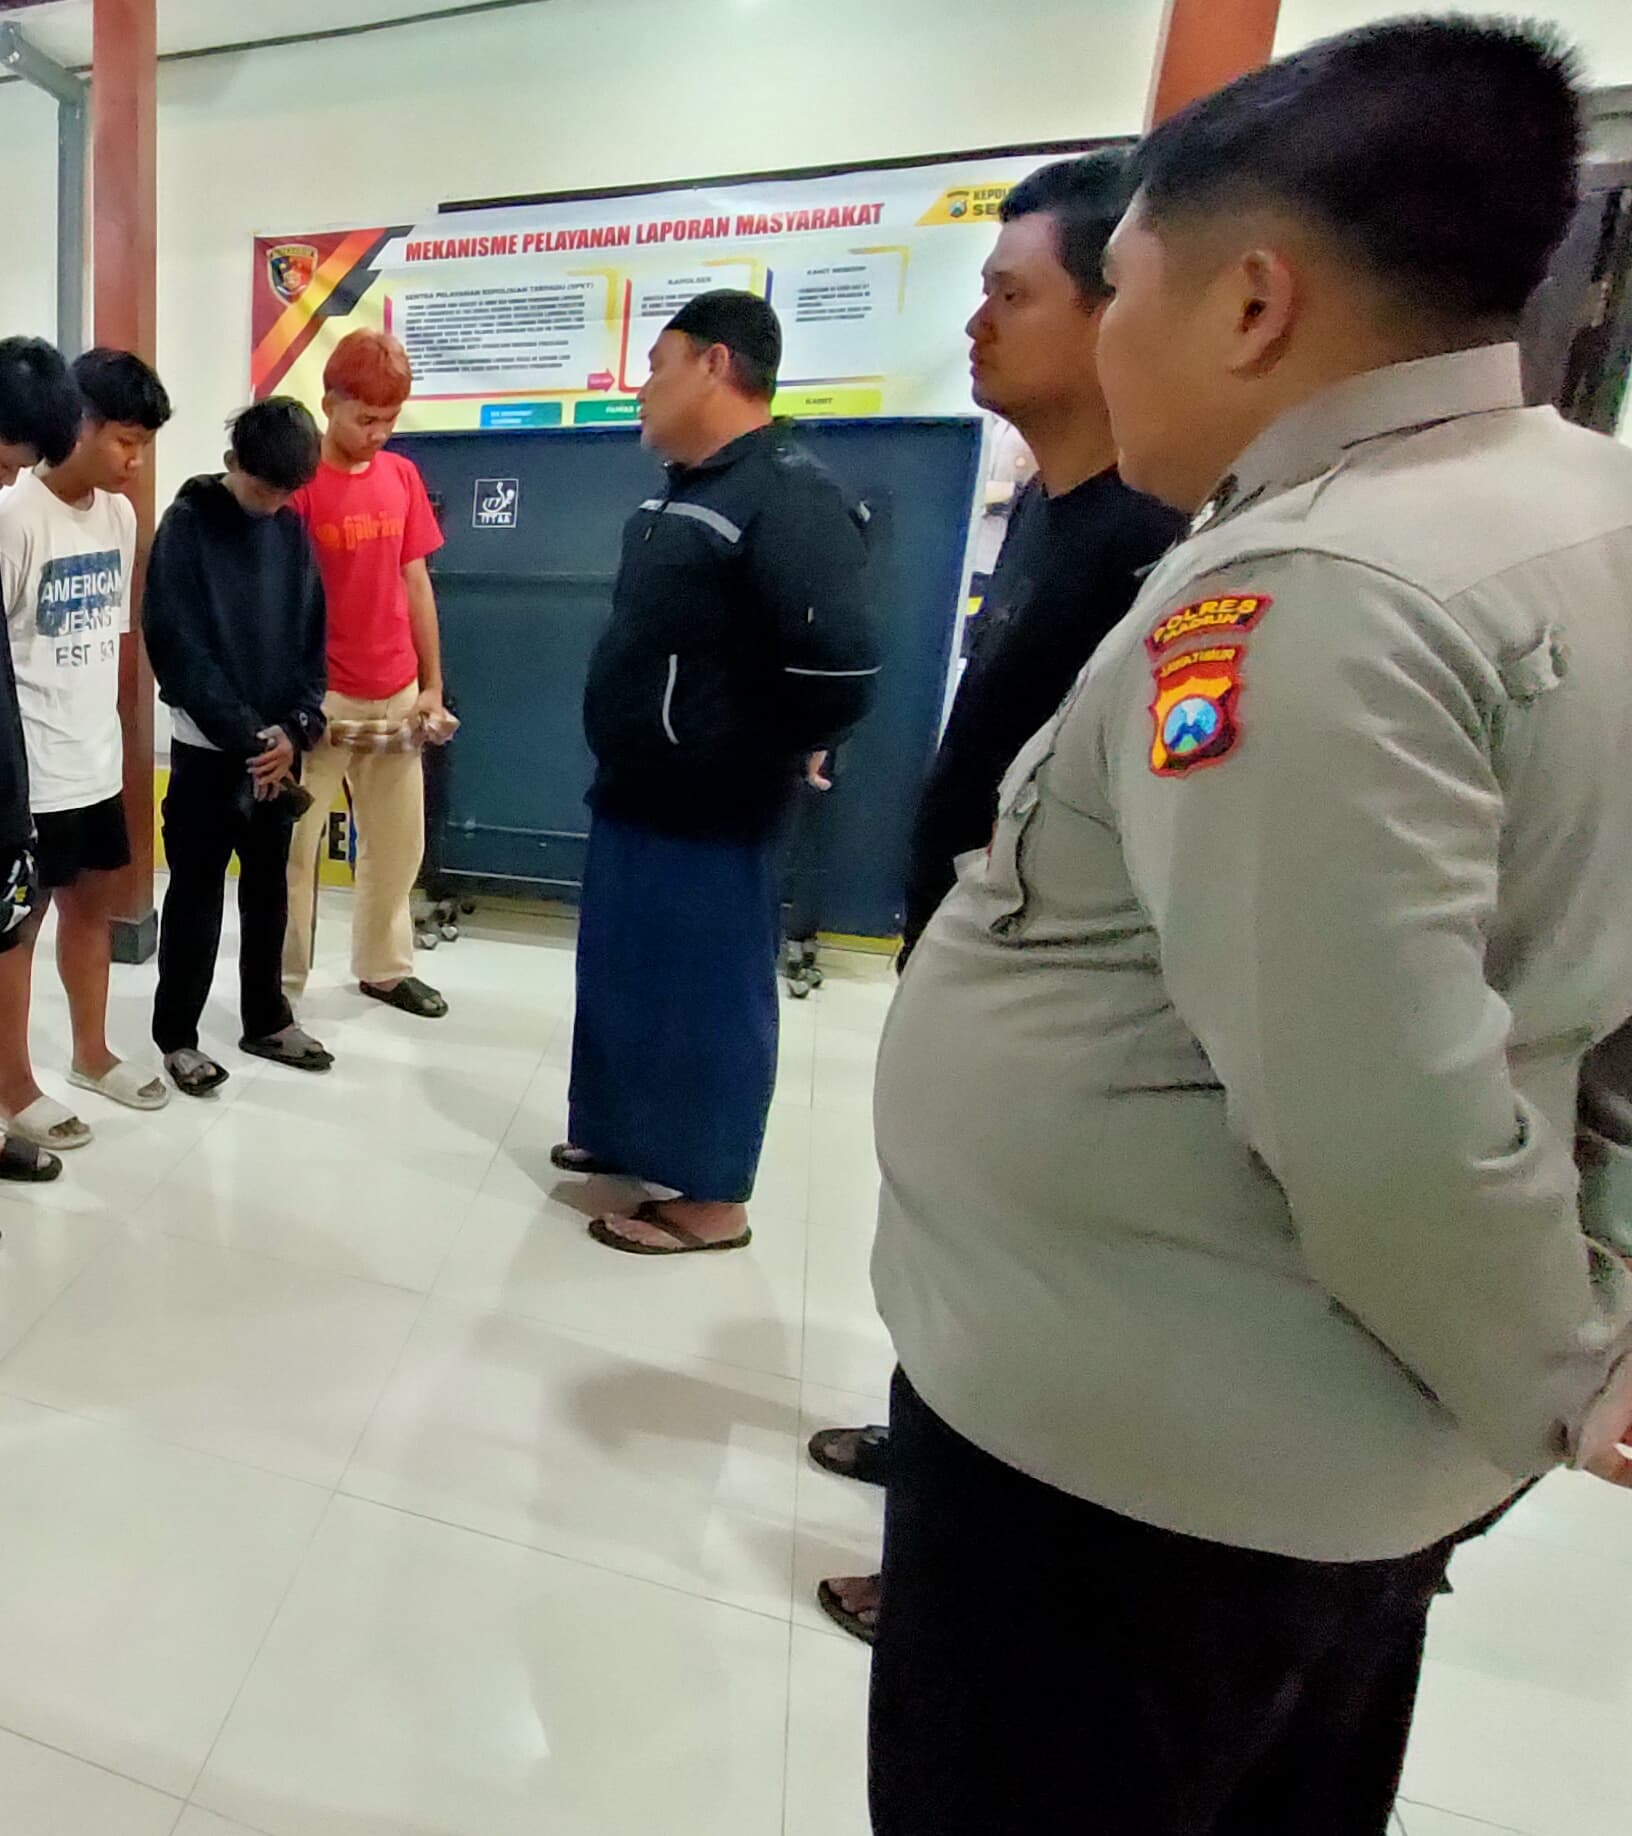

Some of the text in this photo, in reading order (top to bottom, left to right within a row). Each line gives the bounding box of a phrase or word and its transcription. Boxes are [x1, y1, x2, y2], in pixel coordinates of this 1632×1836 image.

[405, 203, 885, 262] MEKANISME PELAYANAN LAPORAN MASYARAKAT
[41, 570, 122, 604] AMERICAN
[58, 605, 113, 636] JEANS
[55, 644, 91, 667] EST
